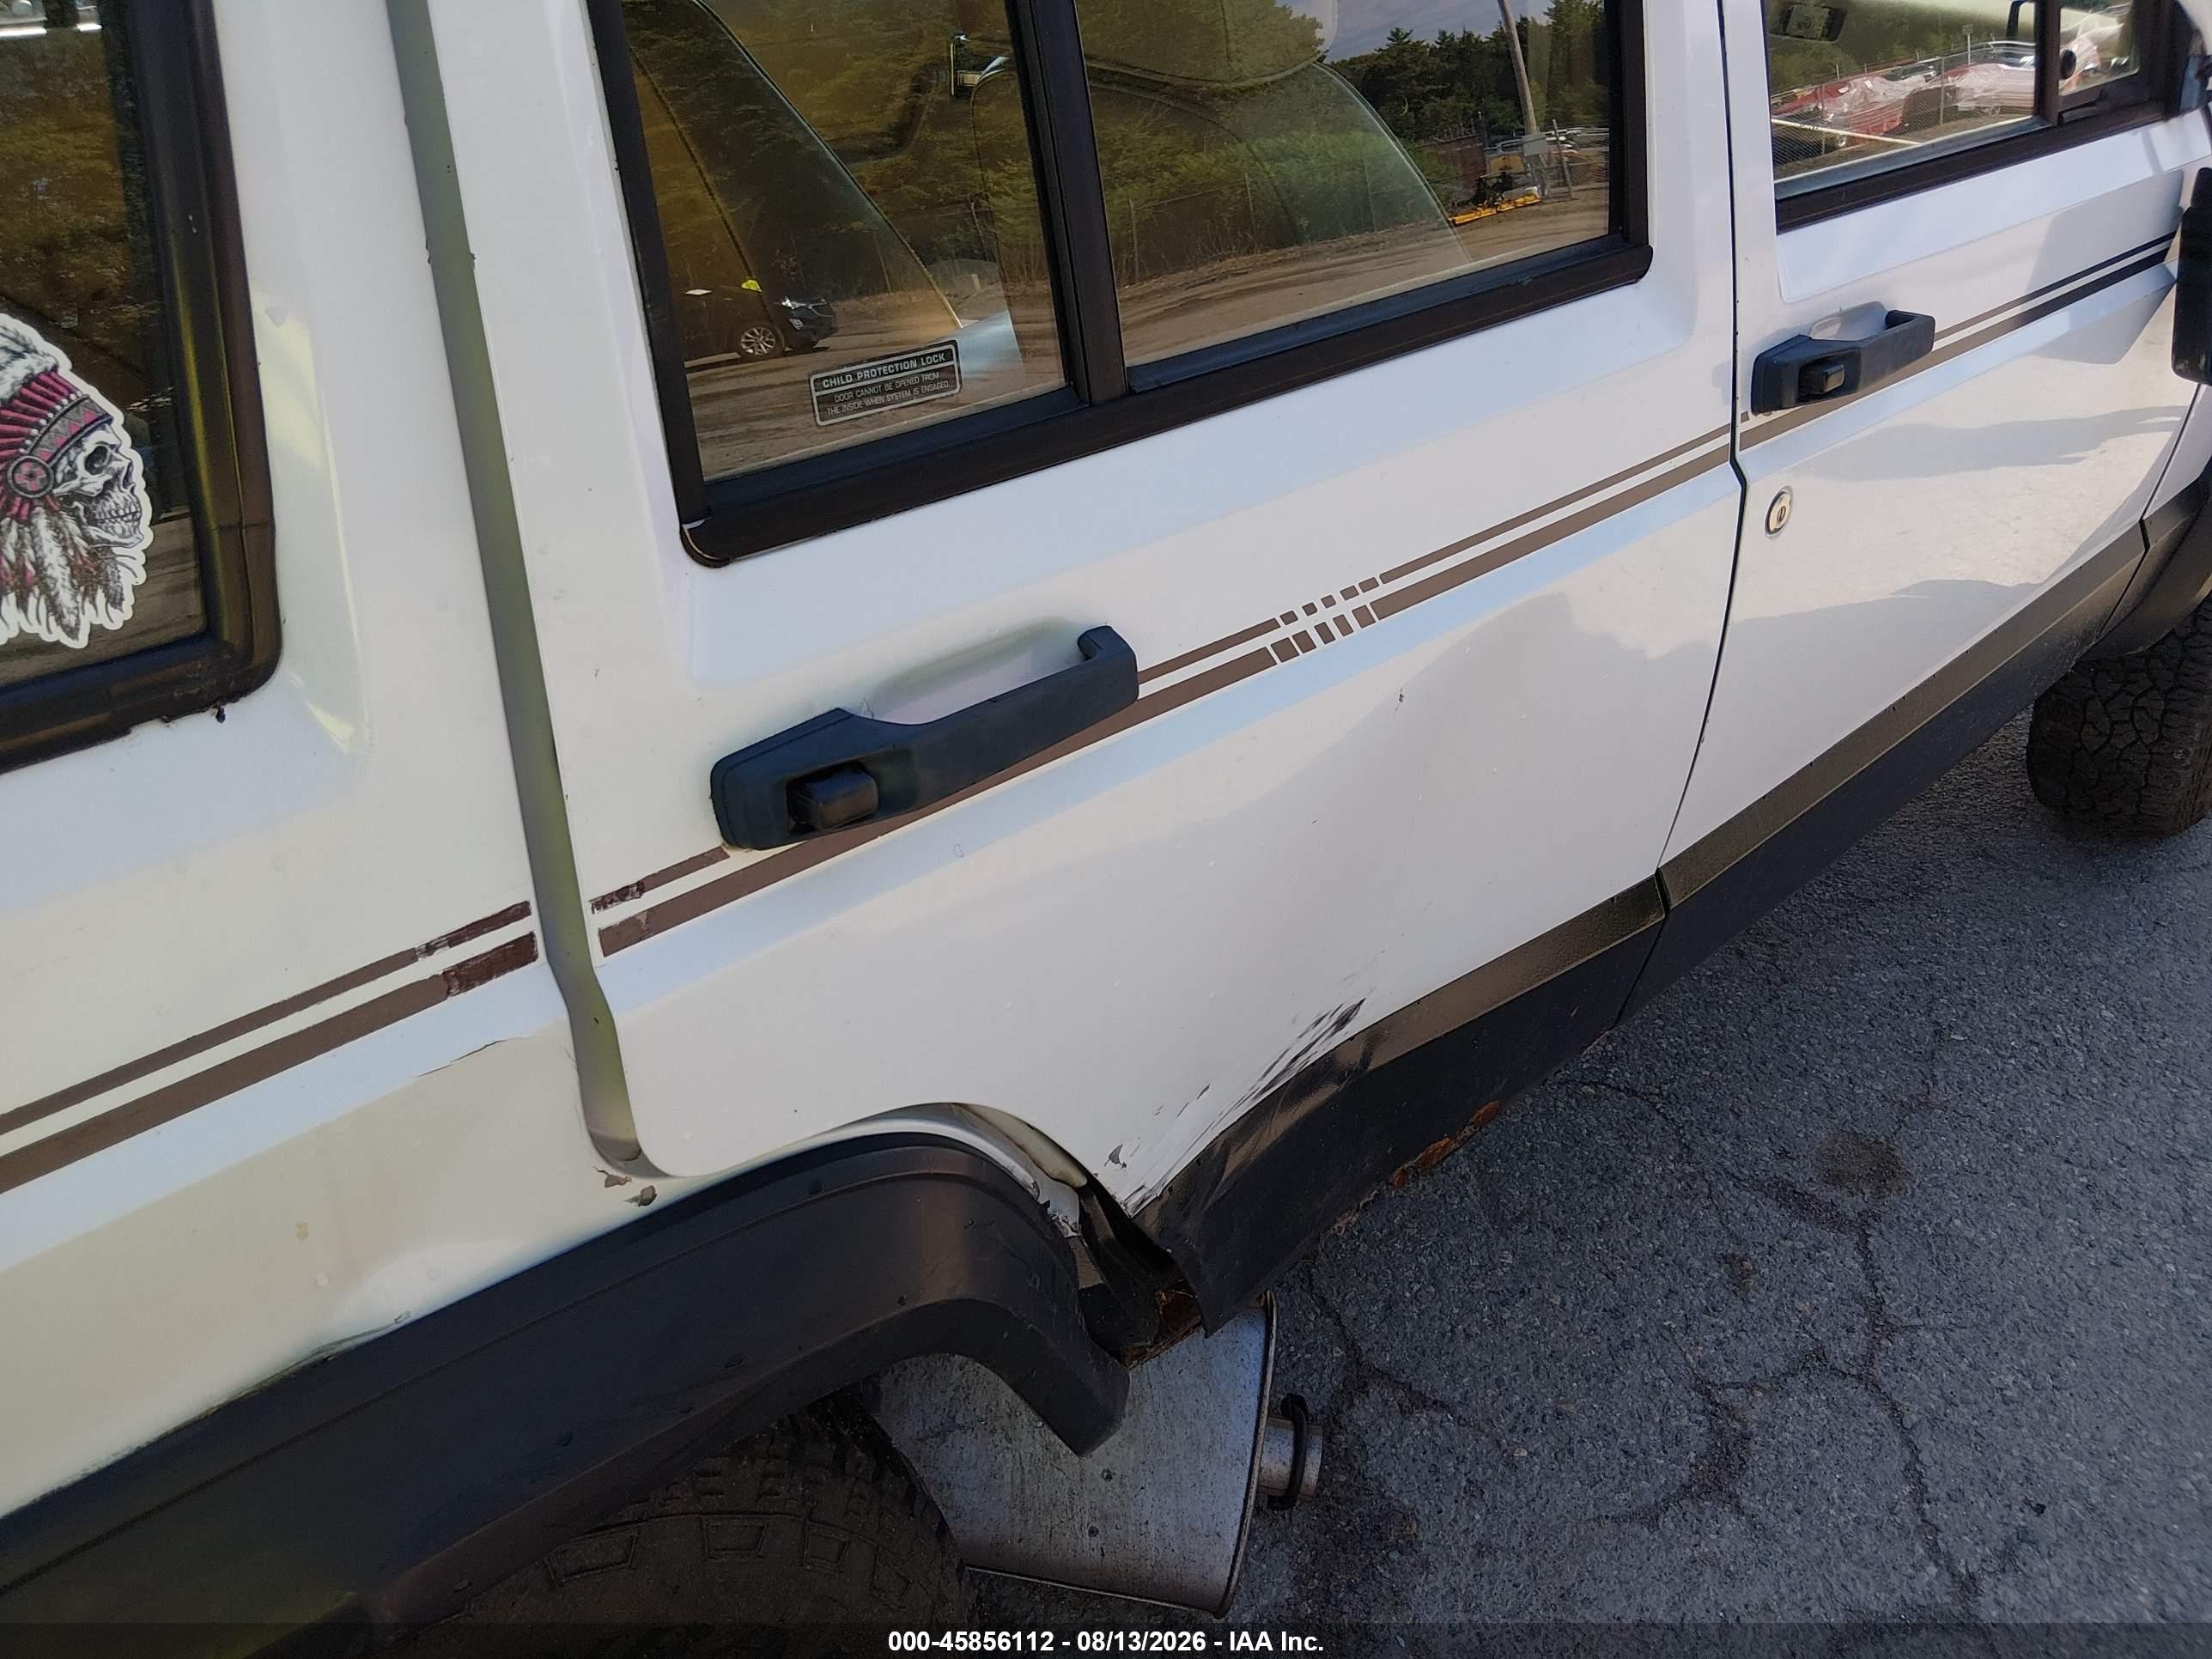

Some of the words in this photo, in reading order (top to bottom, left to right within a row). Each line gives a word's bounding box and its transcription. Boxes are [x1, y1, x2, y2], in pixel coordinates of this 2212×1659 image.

[823, 374, 853, 388] CHILD
[857, 359, 917, 380] PROTECTION
[921, 353, 945, 366] LOCK
[835, 392, 854, 403] DOOR
[856, 385, 882, 398] CANNOT
[896, 376, 920, 388] OPENED
[921, 371, 940, 382] FROM
[827, 406, 841, 415] THE
[842, 400, 863, 412] INSIDE
[865, 396, 884, 406] WHEN
[886, 390, 911, 402] SYSTEM
[913, 387, 920, 396] IS
[921, 380, 949, 392] ENGAGED
